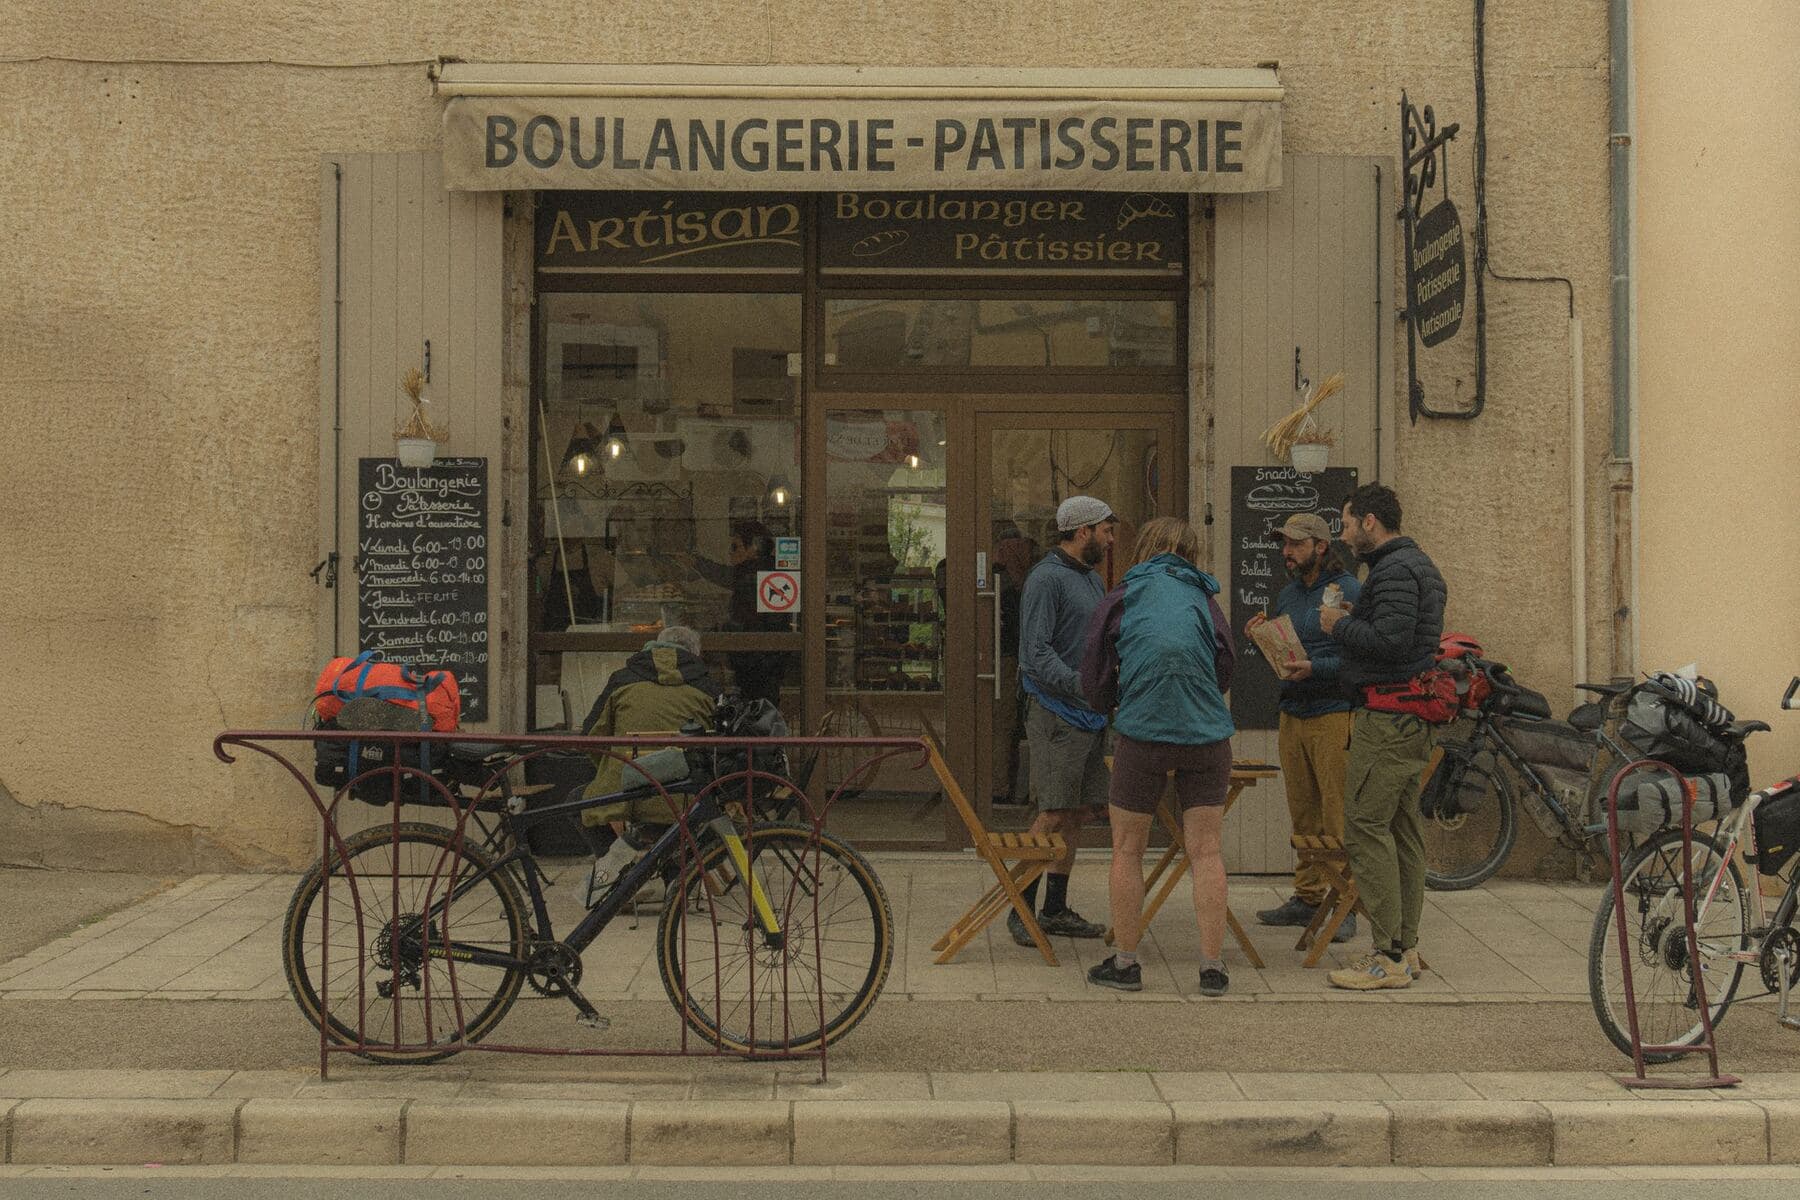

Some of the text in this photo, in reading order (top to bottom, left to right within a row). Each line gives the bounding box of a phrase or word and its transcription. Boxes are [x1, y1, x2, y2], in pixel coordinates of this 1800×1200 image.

[836, 192, 1086, 227] Boulanger
[545, 200, 800, 256] Artisan
[955, 232, 1163, 261] Pâtissier
[1413, 220, 1460, 271] Boulangerie
[1421, 300, 1462, 338] Artisanale
[370, 538, 410, 553] Lundi
[1240, 560, 1272, 576] Salade
[1240, 588, 1270, 617] Wrap
[373, 611, 429, 625] Vendredi
[376, 632, 425, 647] Samedi
